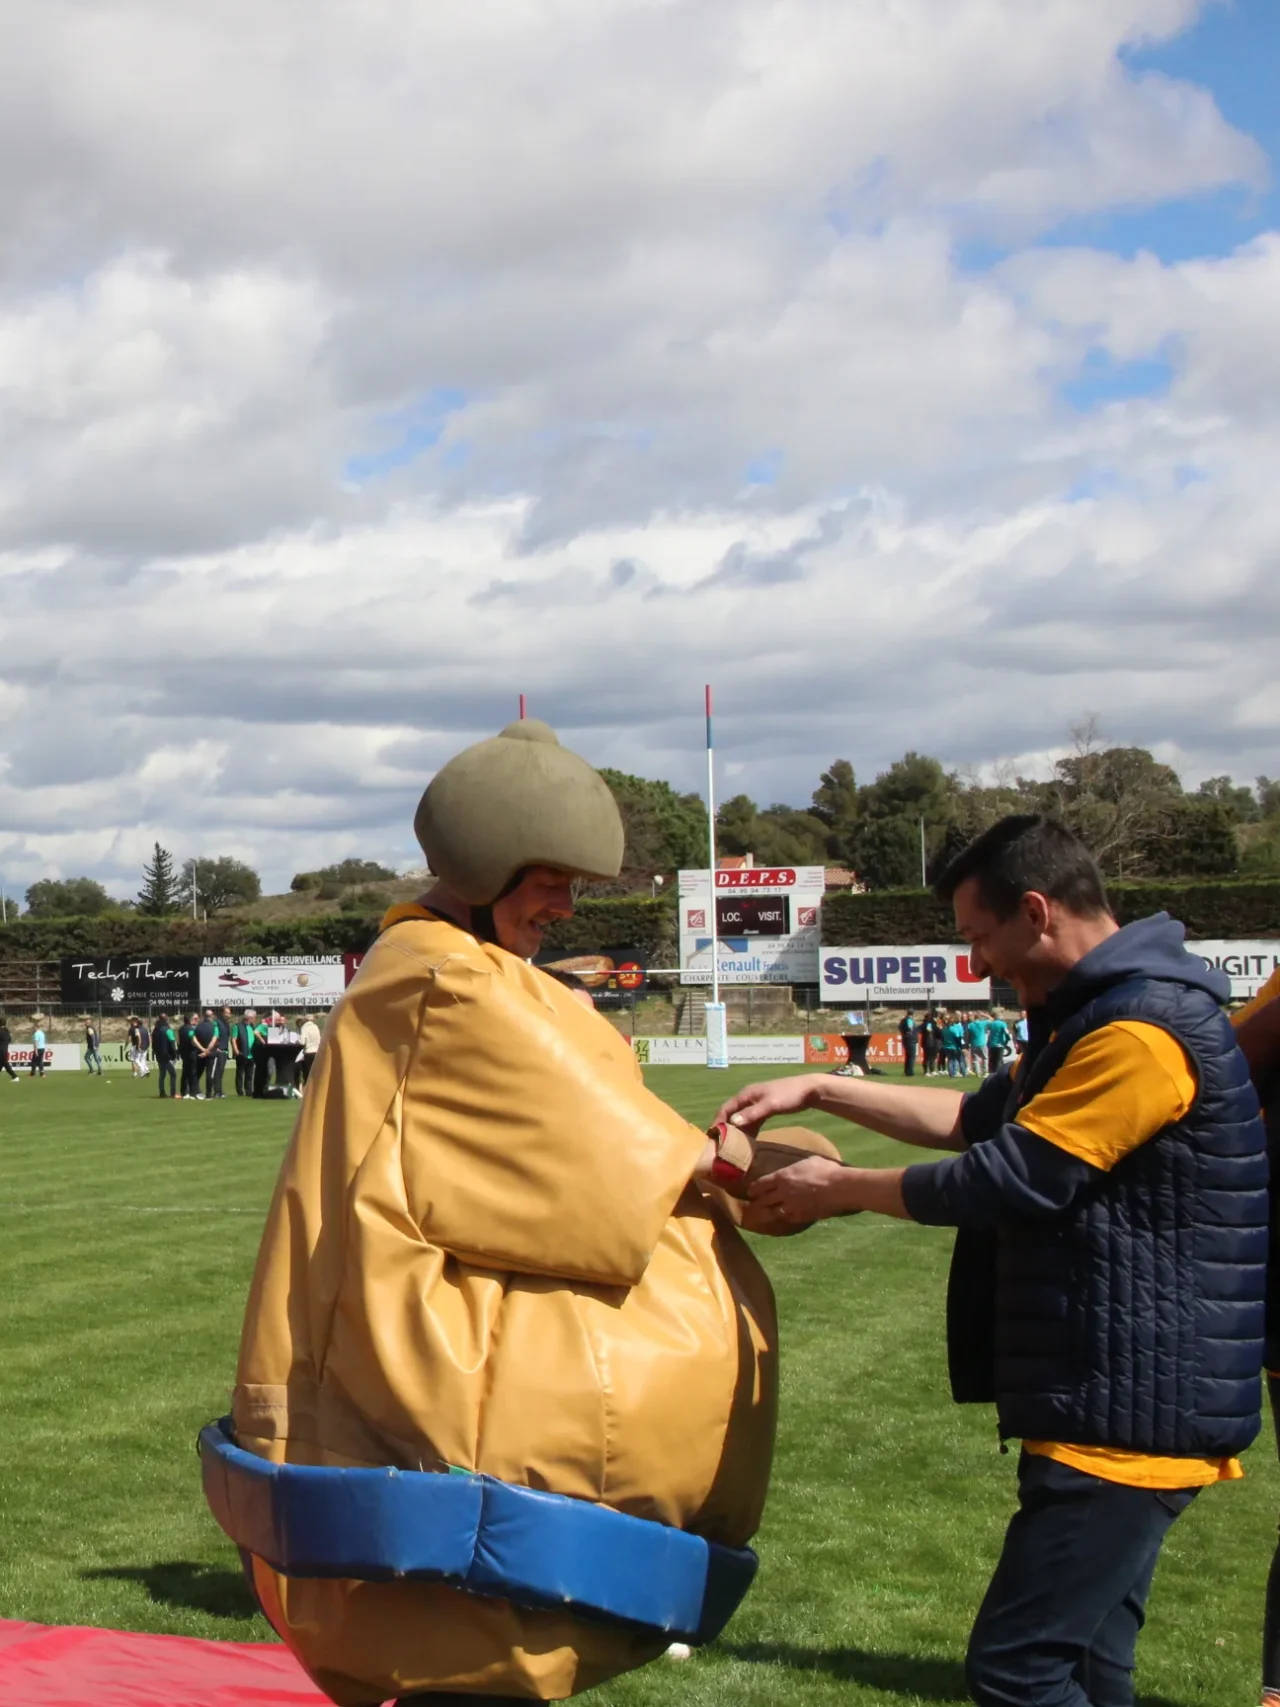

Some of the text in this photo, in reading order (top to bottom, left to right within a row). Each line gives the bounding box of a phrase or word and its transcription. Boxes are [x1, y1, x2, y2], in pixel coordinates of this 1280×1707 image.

[718, 871, 794, 885] D.E.P.S.
[721, 911, 781, 922] LOC. VISIT.
[202, 956, 234, 966] ALARME
[266, 955, 342, 965] TELESURVEILLANCE
[72, 960, 189, 980] TechniTherm
[824, 956, 947, 985] SUPER
[736, 974, 788, 982] COUVERTURE
[149, 991, 189, 999] CLIMATIQUE
[874, 986, 935, 995] Châteaurenard
[214, 998, 246, 1006] BAGNOL
[283, 997, 293, 1005] 04
[653, 1039, 703, 1048] TALEN
